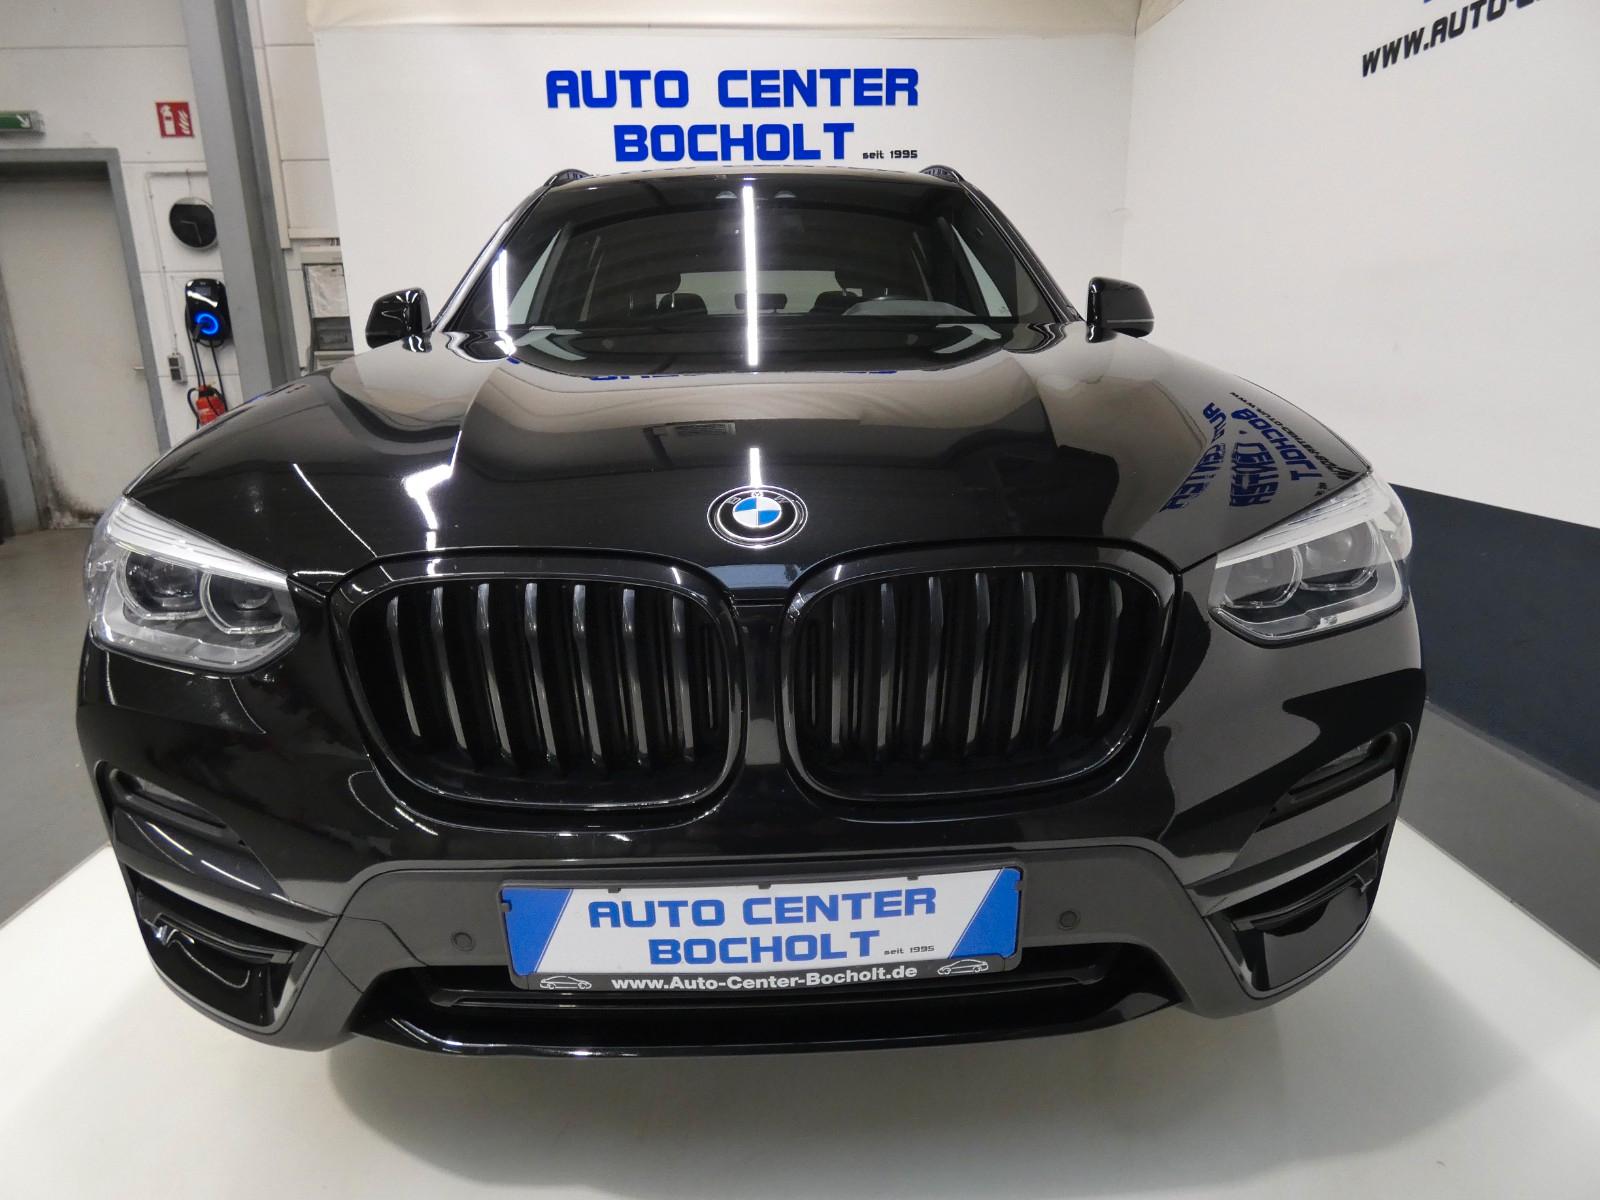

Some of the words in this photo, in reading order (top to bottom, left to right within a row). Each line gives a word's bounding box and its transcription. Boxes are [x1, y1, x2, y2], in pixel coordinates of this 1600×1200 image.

[1361, 0, 1540, 77] WWW.AUTO
[546, 70, 688, 108] AUTO
[717, 68, 918, 107] CENTER
[614, 123, 854, 161] BOCHOLT
[862, 150, 884, 159] seit
[890, 150, 918, 159] 1995
[588, 900, 725, 929] AUTO
[743, 888, 936, 926] CENTER
[648, 930, 880, 965] BOCHOLT
[910, 945, 935, 953] 1995
[611, 965, 918, 991] www.Auto-Center-Bocholt.de
